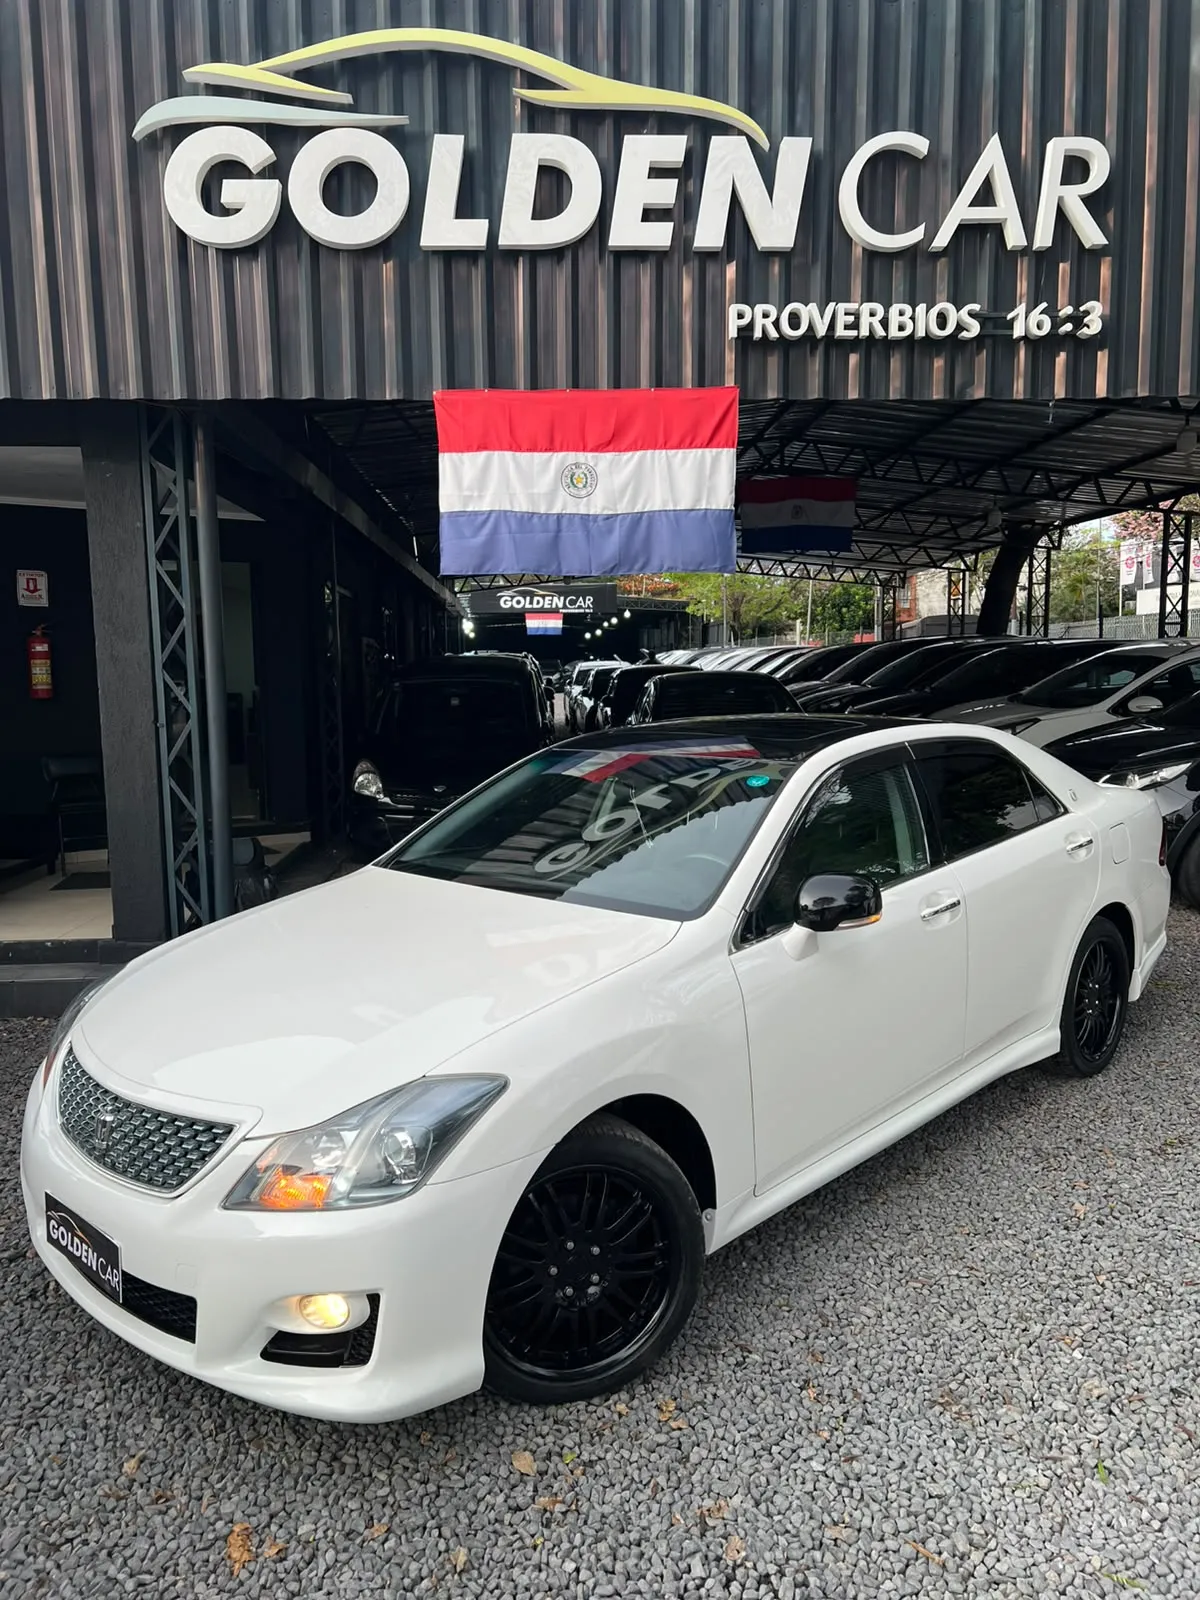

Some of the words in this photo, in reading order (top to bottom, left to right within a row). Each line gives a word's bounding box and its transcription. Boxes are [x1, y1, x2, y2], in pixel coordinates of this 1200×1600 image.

[163, 125, 812, 252] GOLDEN
[838, 131, 1111, 252] CAR
[728, 301, 981, 341] PROVERBIOS
[499, 595, 565, 609] GOLDEN
[565, 595, 594, 609] CAR
[49, 1219, 97, 1271] GOLDEN
[97, 1257, 120, 1292] CAR
